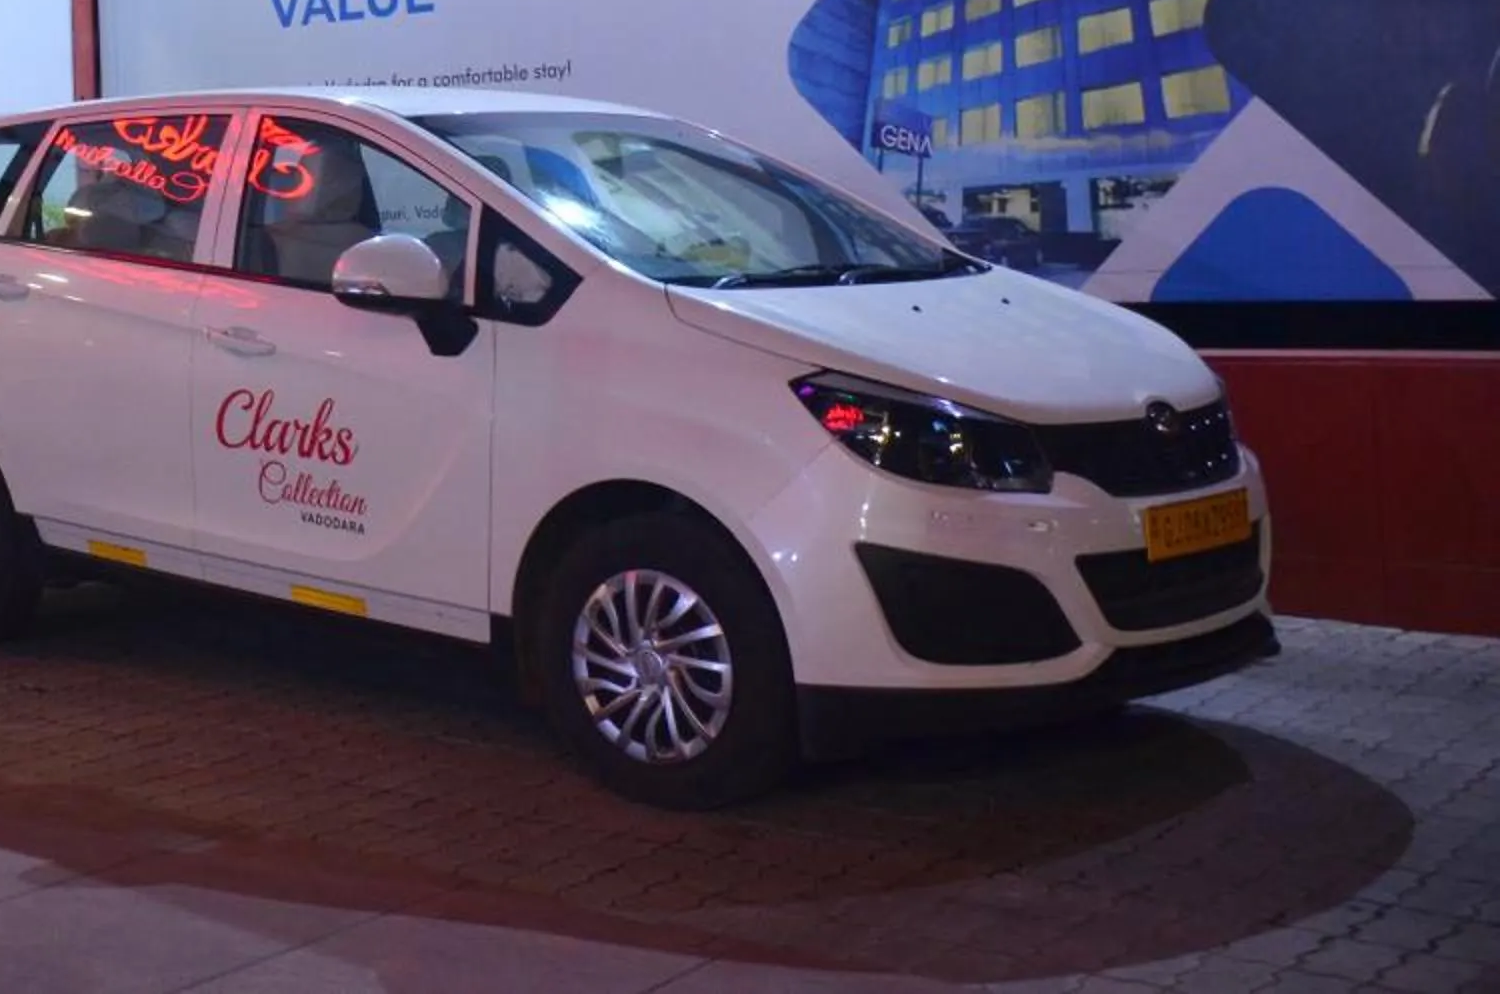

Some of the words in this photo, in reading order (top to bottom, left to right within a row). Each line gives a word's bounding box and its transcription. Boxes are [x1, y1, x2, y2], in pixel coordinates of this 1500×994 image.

[433, 64, 528, 88] comfortable
[533, 59, 572, 82] stay!
[216, 389, 359, 465] Clarks
[259, 459, 367, 515] Collection
[301, 512, 366, 534] VADODARA
